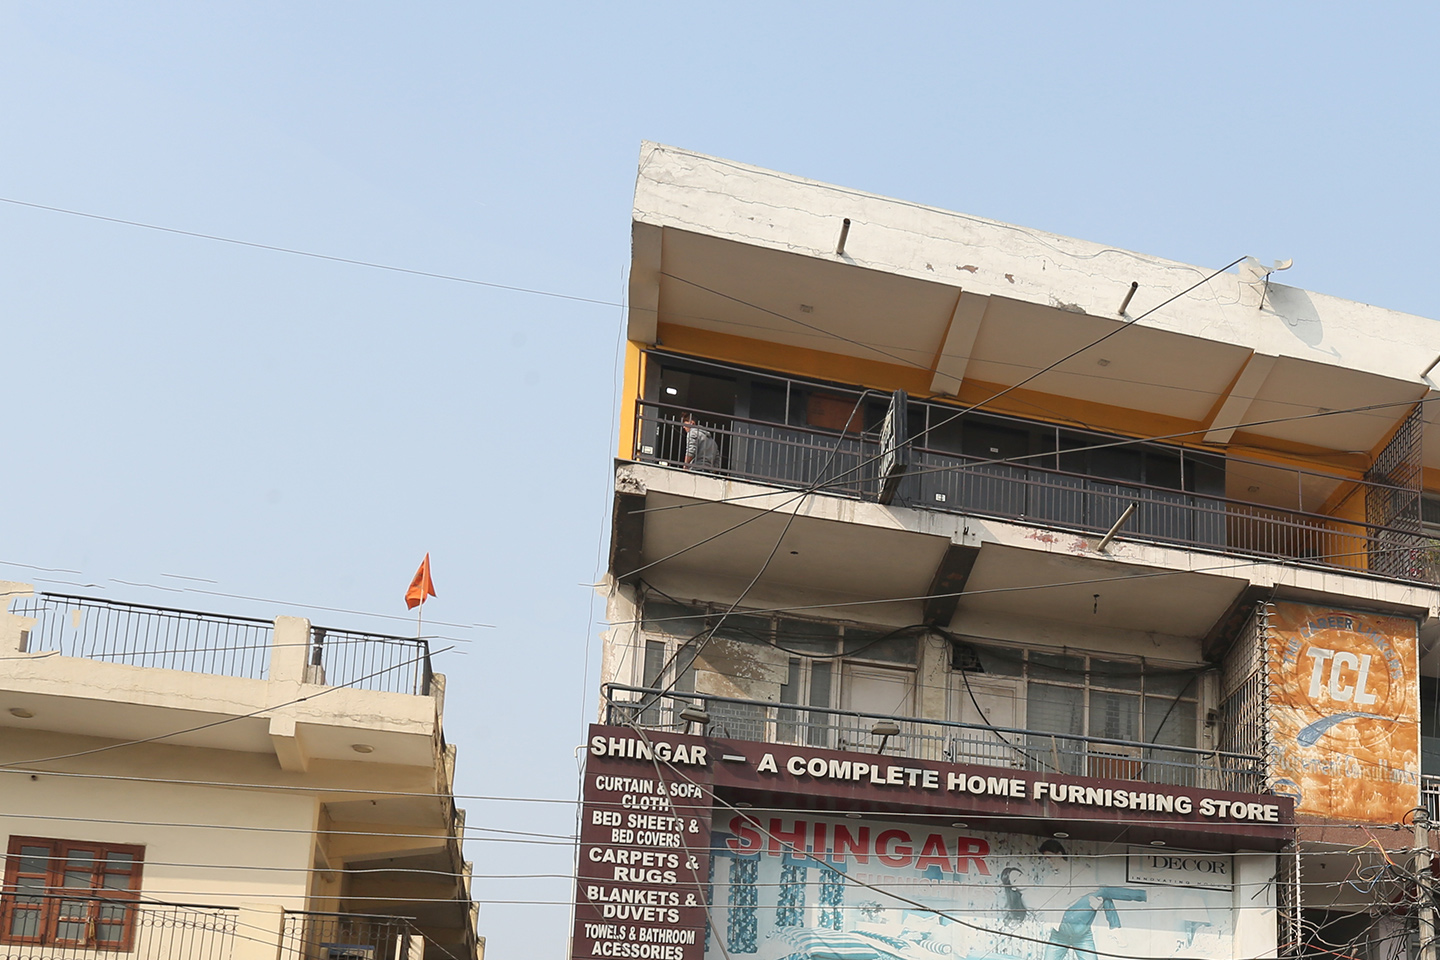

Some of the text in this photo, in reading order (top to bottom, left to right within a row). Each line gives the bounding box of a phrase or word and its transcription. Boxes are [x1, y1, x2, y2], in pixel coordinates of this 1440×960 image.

[1301, 616, 1353, 637] CAREER
[1357, 622, 1403, 680] LINKERS
[1306, 647, 1377, 705] TCL
[590, 736, 707, 765] SHINGAR
[758, 754, 938, 789] A COMPLETE
[595, 776, 702, 799] CURTAIN SOFA
[947, 773, 1279, 822] HOME FURNISHING STORE
[622, 794, 669, 812] CLOTH
[593, 811, 684, 832] BED SHEETS
[612, 829, 680, 848] BED COVERS
[726, 813, 992, 878] SHINGAR
[590, 848, 678, 868] CARPETS
[614, 866, 677, 884] RUGS
[588, 886, 679, 904] BLANKETS
[603, 904, 679, 922] DUVETS
[585, 924, 695, 945] TOWELS BATHROOM
[592, 942, 683, 960] ACESSORIES
